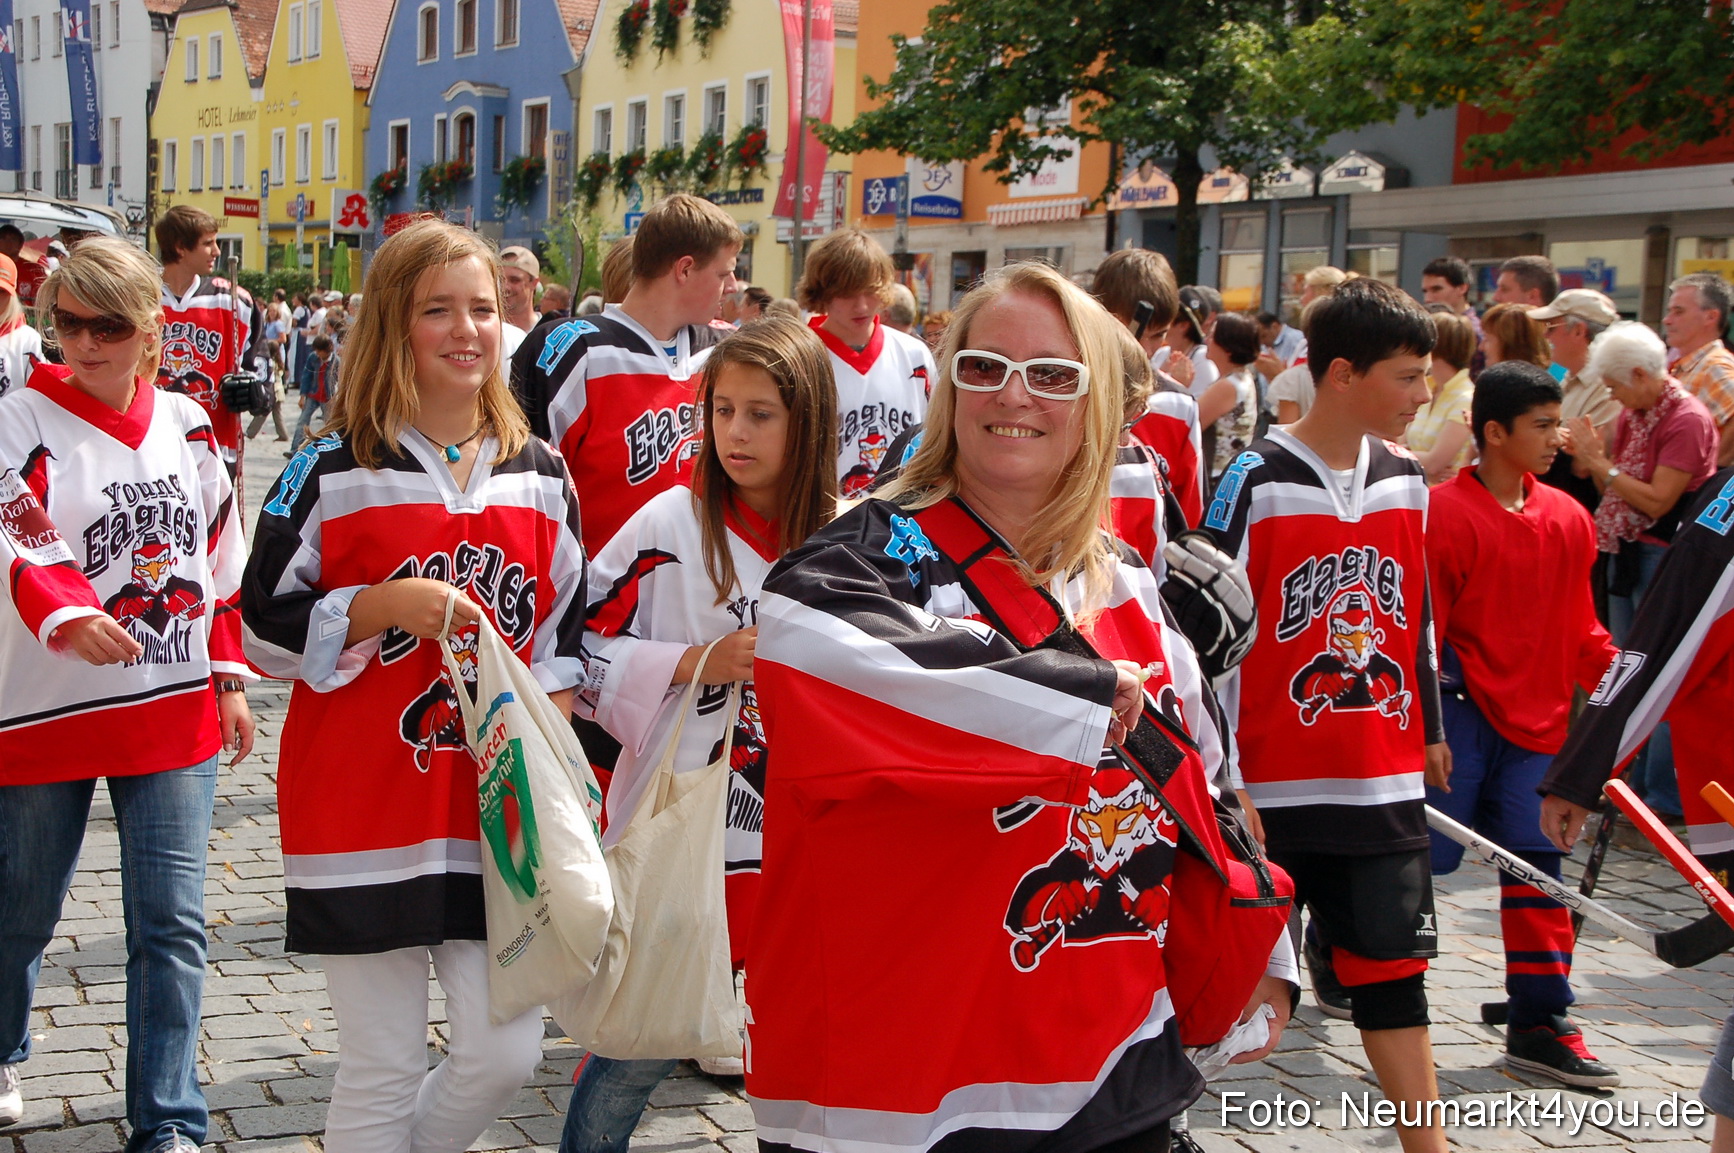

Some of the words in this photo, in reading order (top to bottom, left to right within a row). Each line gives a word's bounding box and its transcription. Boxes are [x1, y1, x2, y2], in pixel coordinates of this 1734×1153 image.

[198, 107, 223, 129] HOTEL
[913, 202, 959, 216] Reisebüro
[160, 321, 223, 363] agles
[624, 401, 706, 486] Eag
[838, 402, 914, 457] agles
[102, 473, 188, 512] Young
[5, 521, 23, 535] &
[82, 500, 198, 581] Eagles
[1276, 546, 1408, 643] Eagle
[495, 922, 533, 963] BIONORICA
